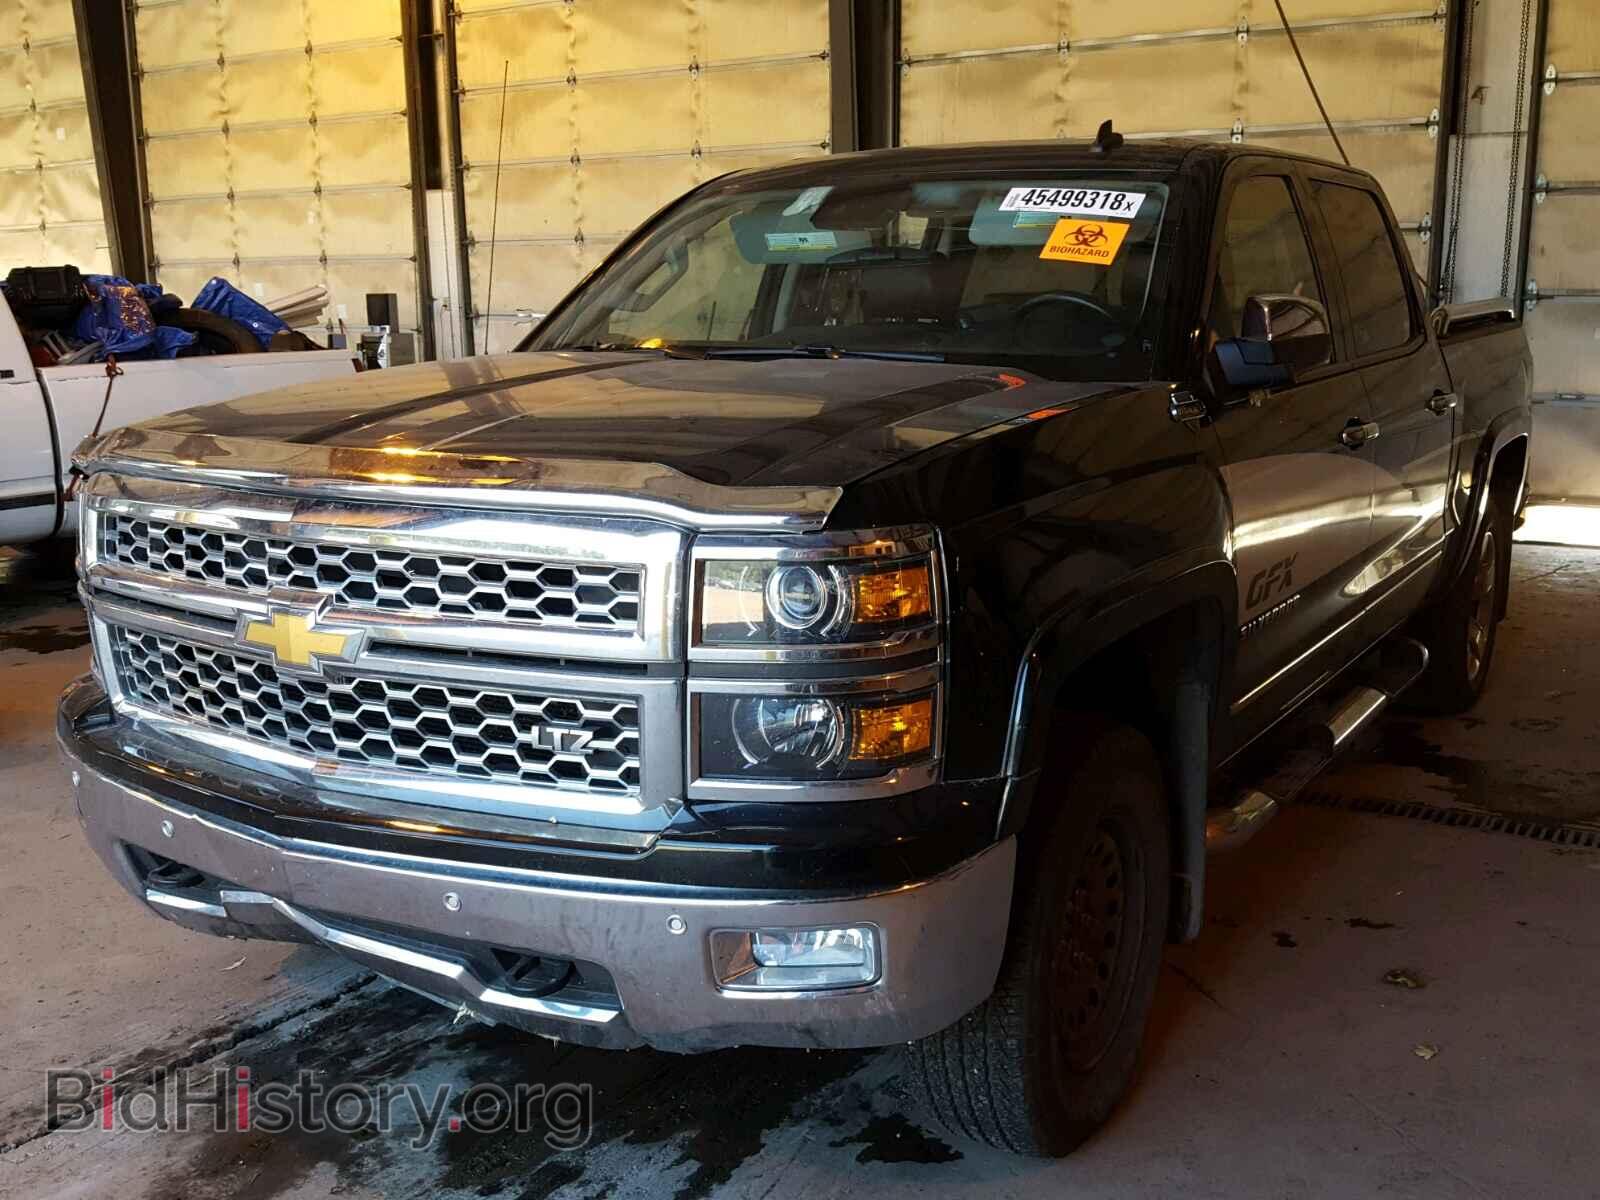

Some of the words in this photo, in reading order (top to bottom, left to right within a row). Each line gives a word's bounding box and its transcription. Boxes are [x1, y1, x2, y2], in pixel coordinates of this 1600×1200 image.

[1049, 246, 1109, 258] BIOHAZARD
[1246, 552, 1299, 609] GFX
[530, 725, 593, 754] LTZ
